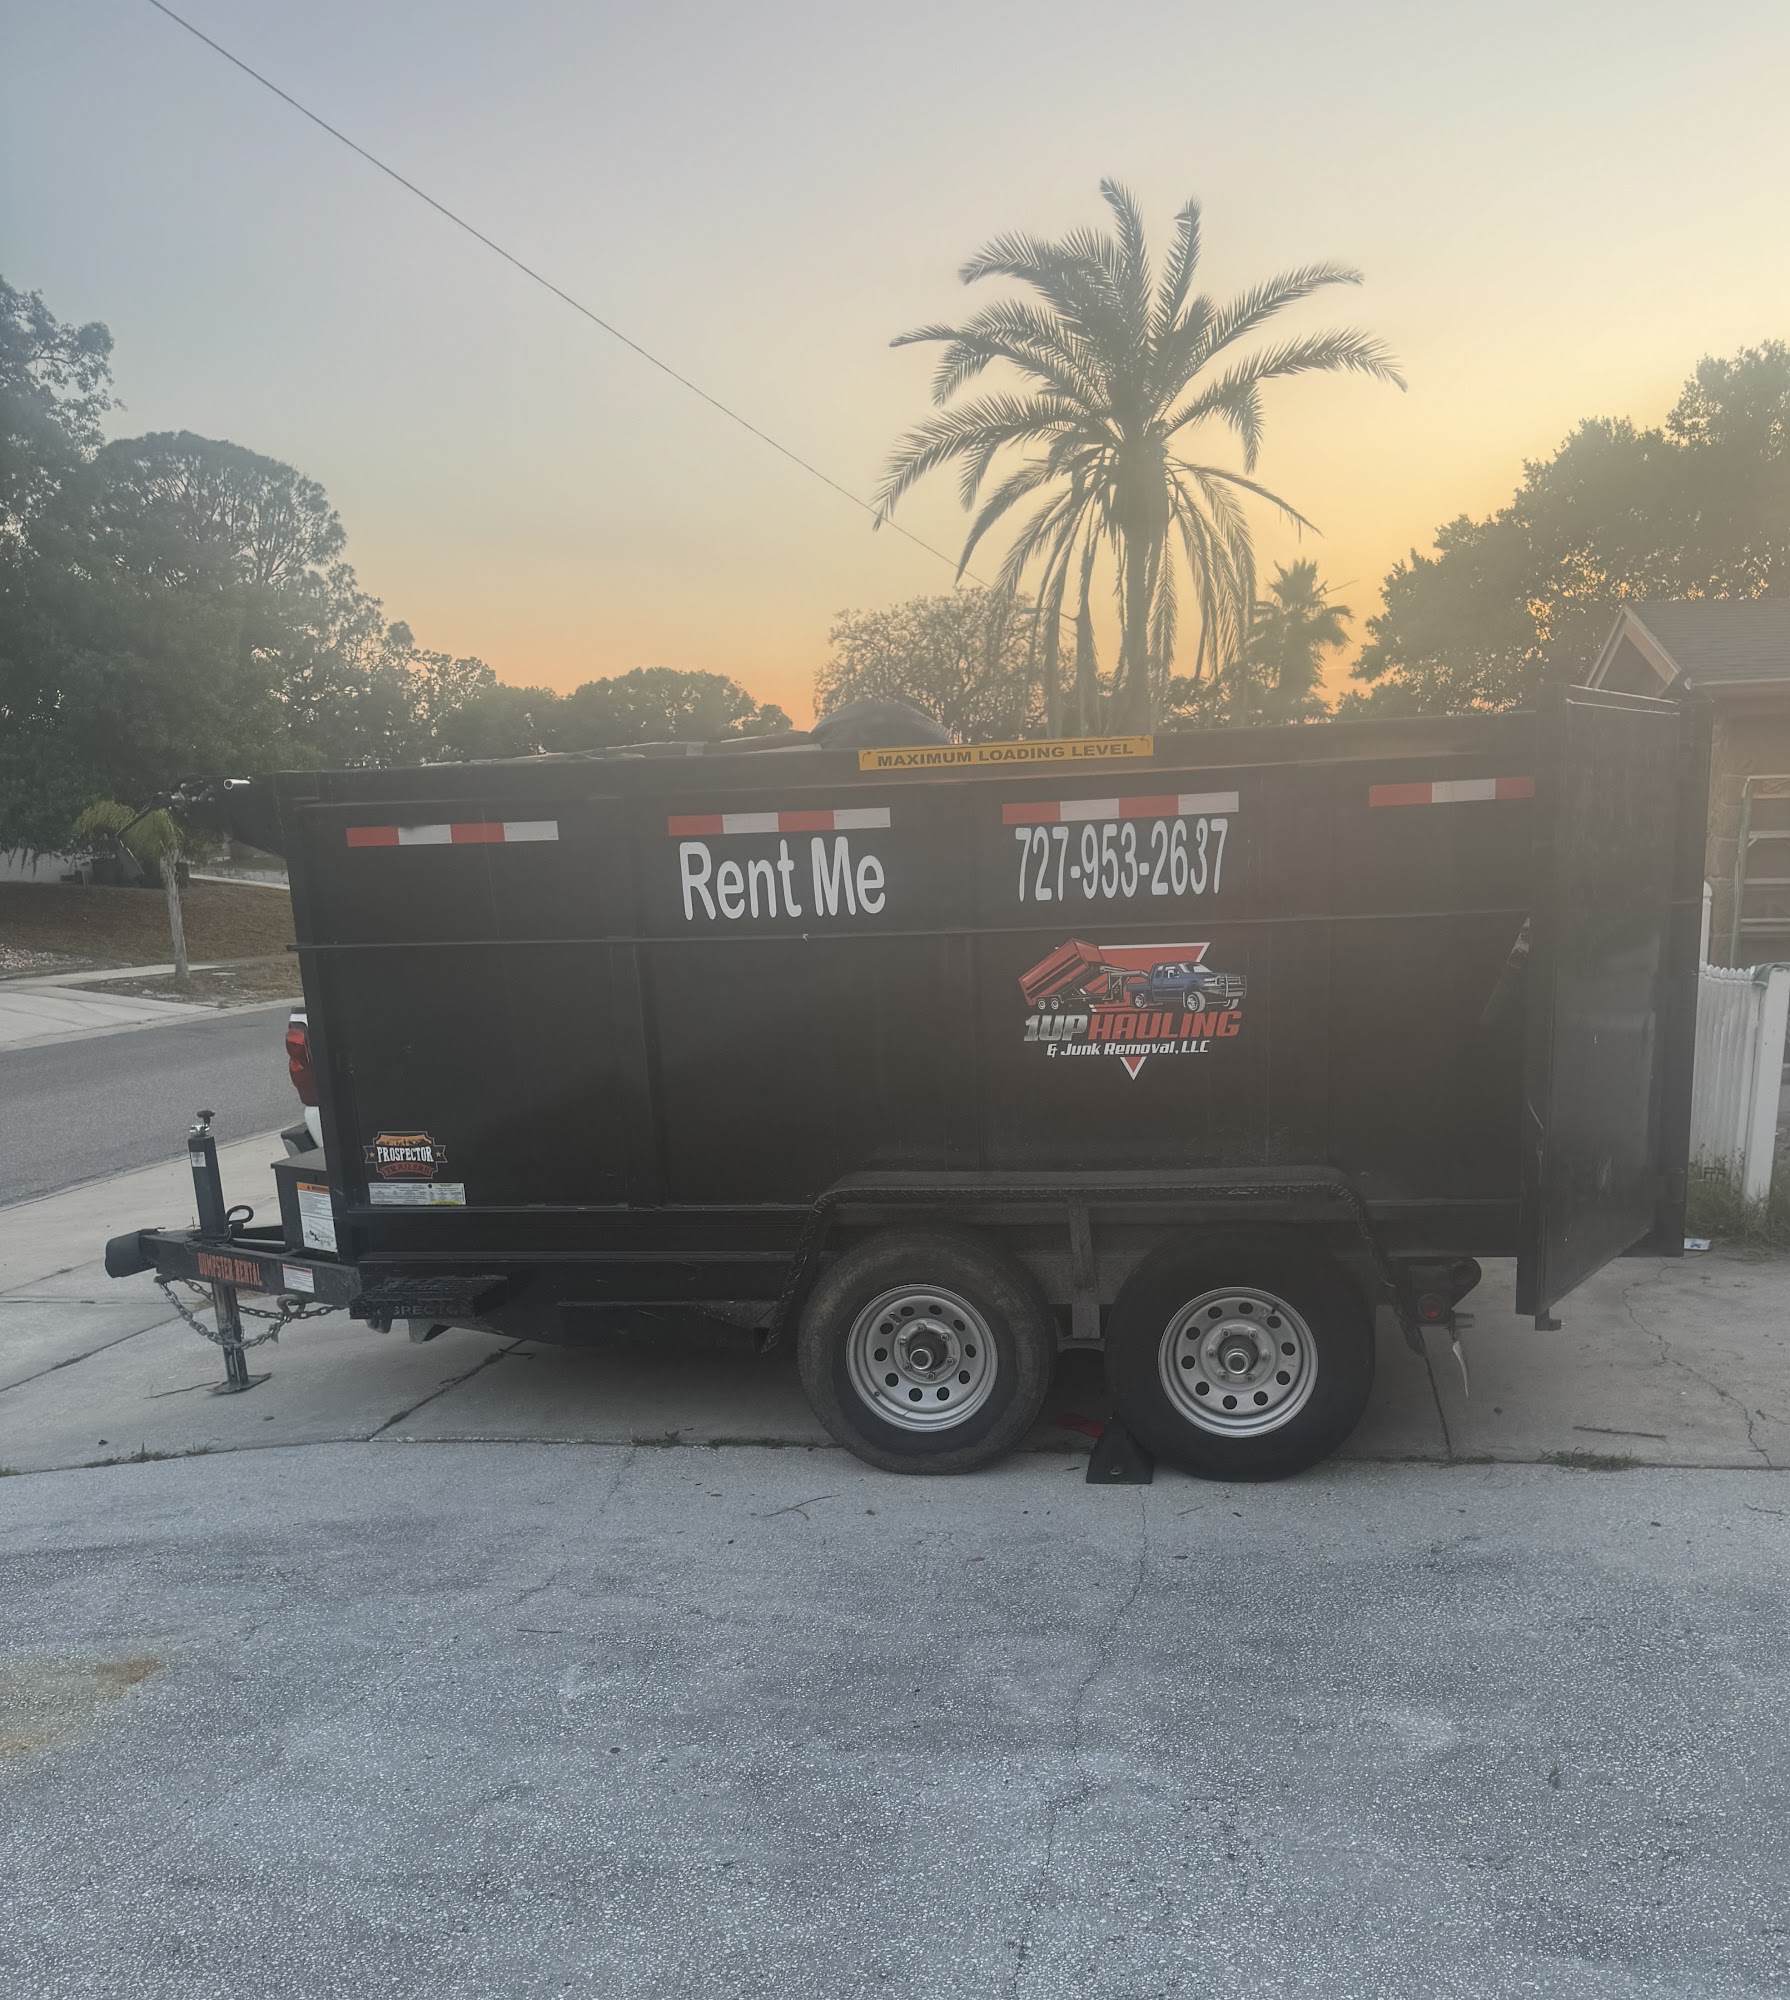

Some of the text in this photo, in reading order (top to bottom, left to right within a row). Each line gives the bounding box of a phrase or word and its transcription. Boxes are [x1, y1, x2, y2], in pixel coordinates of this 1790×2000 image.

[877, 742, 1134, 767] MAXIMUM LOADING LEVEL
[1015, 817, 1229, 902] 727-953-2637
[679, 836, 886, 921] Rent Me
[1023, 1010, 1242, 1042] 1UP HAULING
[1046, 1040, 1211, 1057] & Junk Removal, LLC
[376, 1146, 435, 1163] PROSPECTOR
[385, 1163, 430, 1175] TRAILERS
[197, 1252, 234, 1280] DUMPSTER
[234, 1259, 263, 1287] RENTAL
